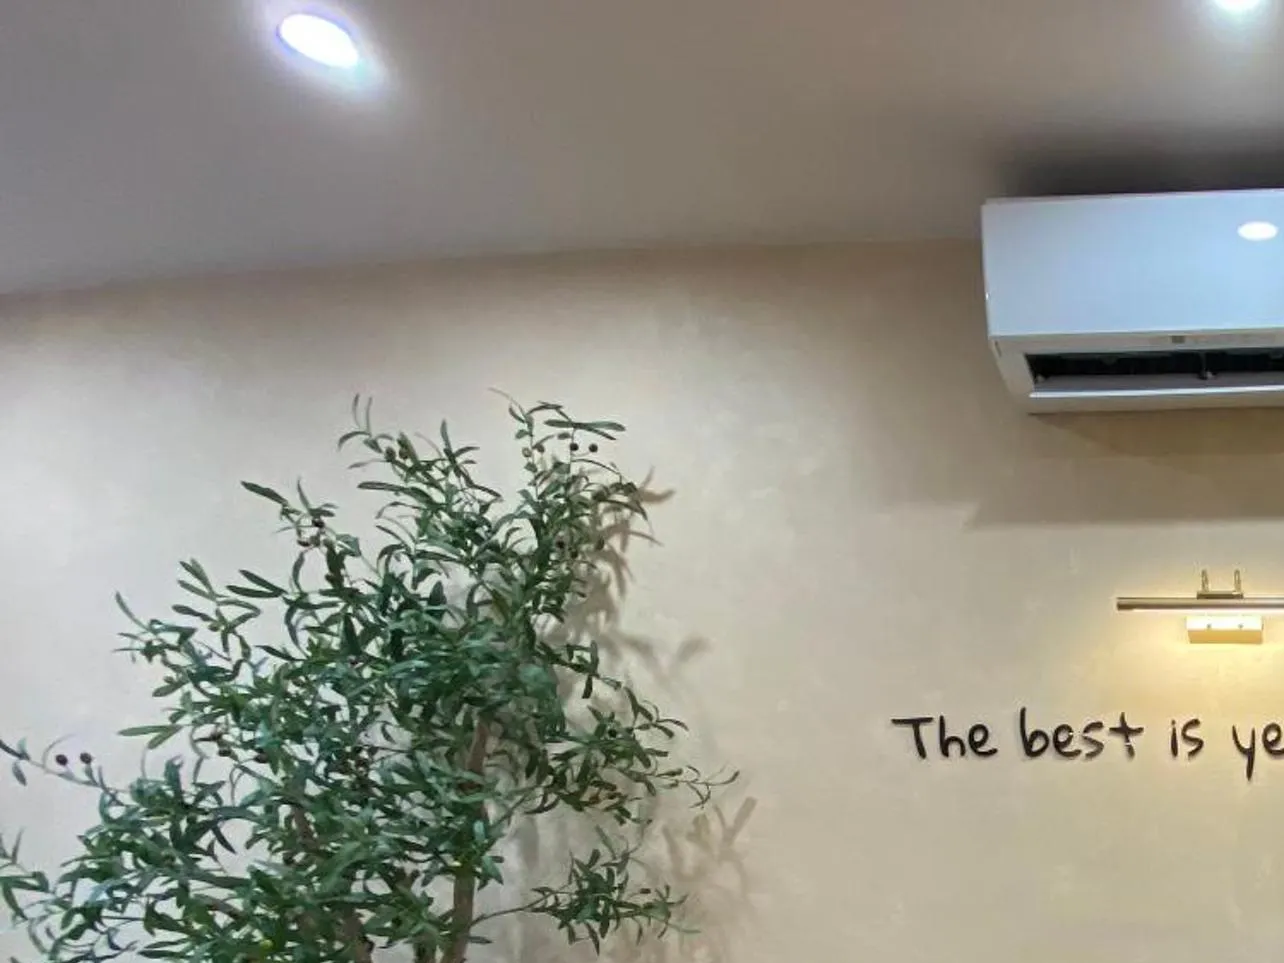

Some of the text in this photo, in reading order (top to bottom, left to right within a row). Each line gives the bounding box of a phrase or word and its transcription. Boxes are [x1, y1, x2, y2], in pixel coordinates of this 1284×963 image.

[890, 715, 1000, 760] The
[1019, 706, 1145, 760] best
[1169, 717, 1206, 759] is
